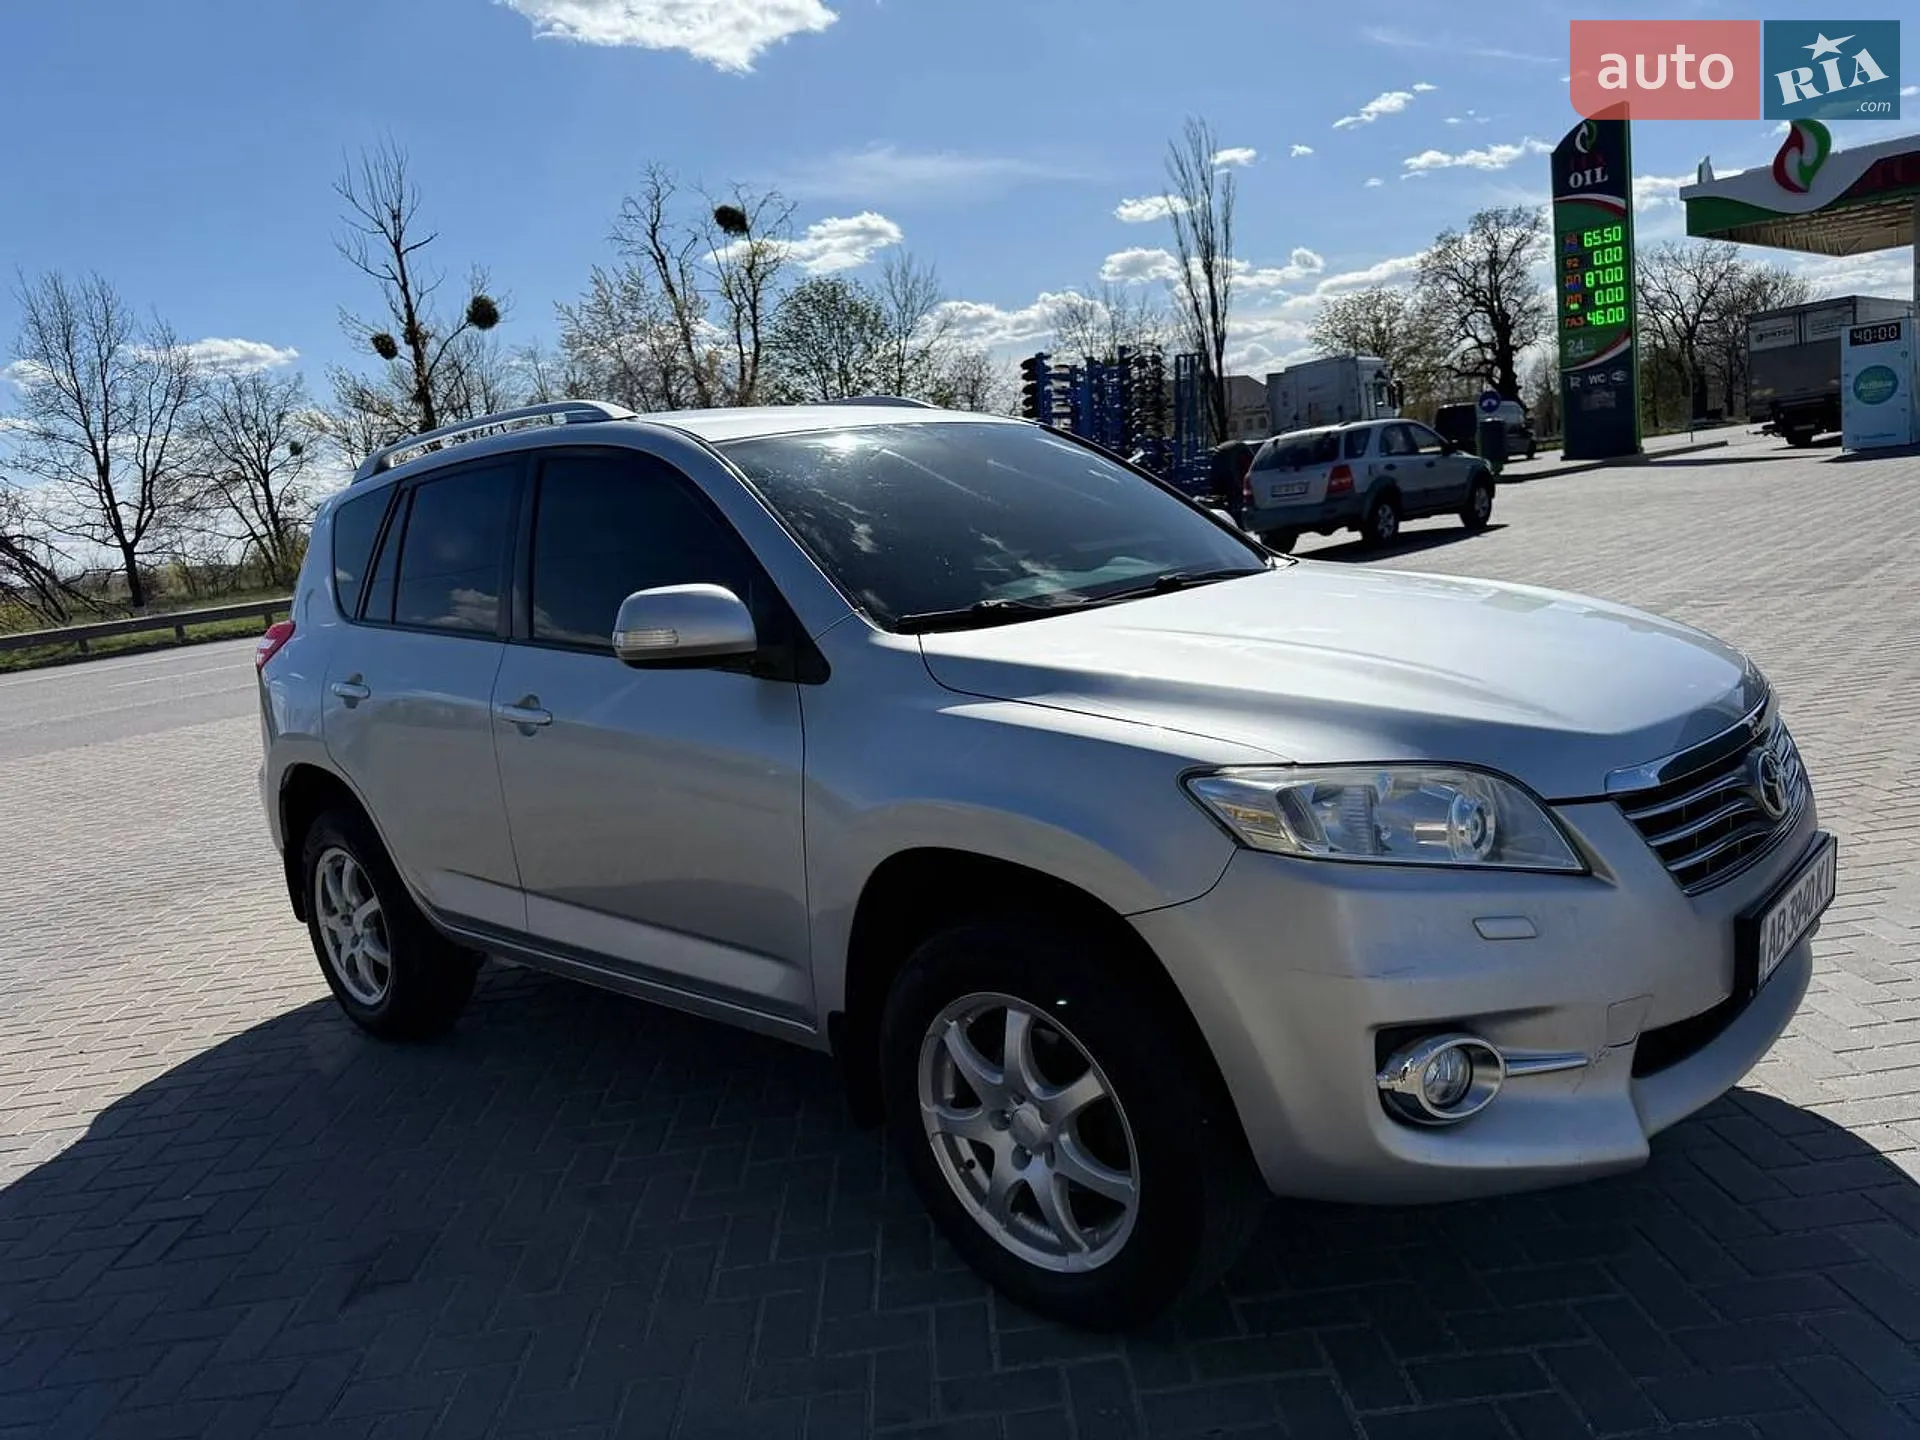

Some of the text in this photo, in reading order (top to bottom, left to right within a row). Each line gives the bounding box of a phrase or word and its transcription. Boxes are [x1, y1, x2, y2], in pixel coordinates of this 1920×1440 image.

[1568, 166, 1609, 188] OIL
[1583, 226, 1622, 247] 65.50
[1593, 246, 1623, 266] 0.00
[1585, 266, 1623, 288] 87.00
[1595, 286, 1624, 305] 0.00
[1587, 306, 1625, 325] 46.00
[1767, 907, 1786, 969] AB
